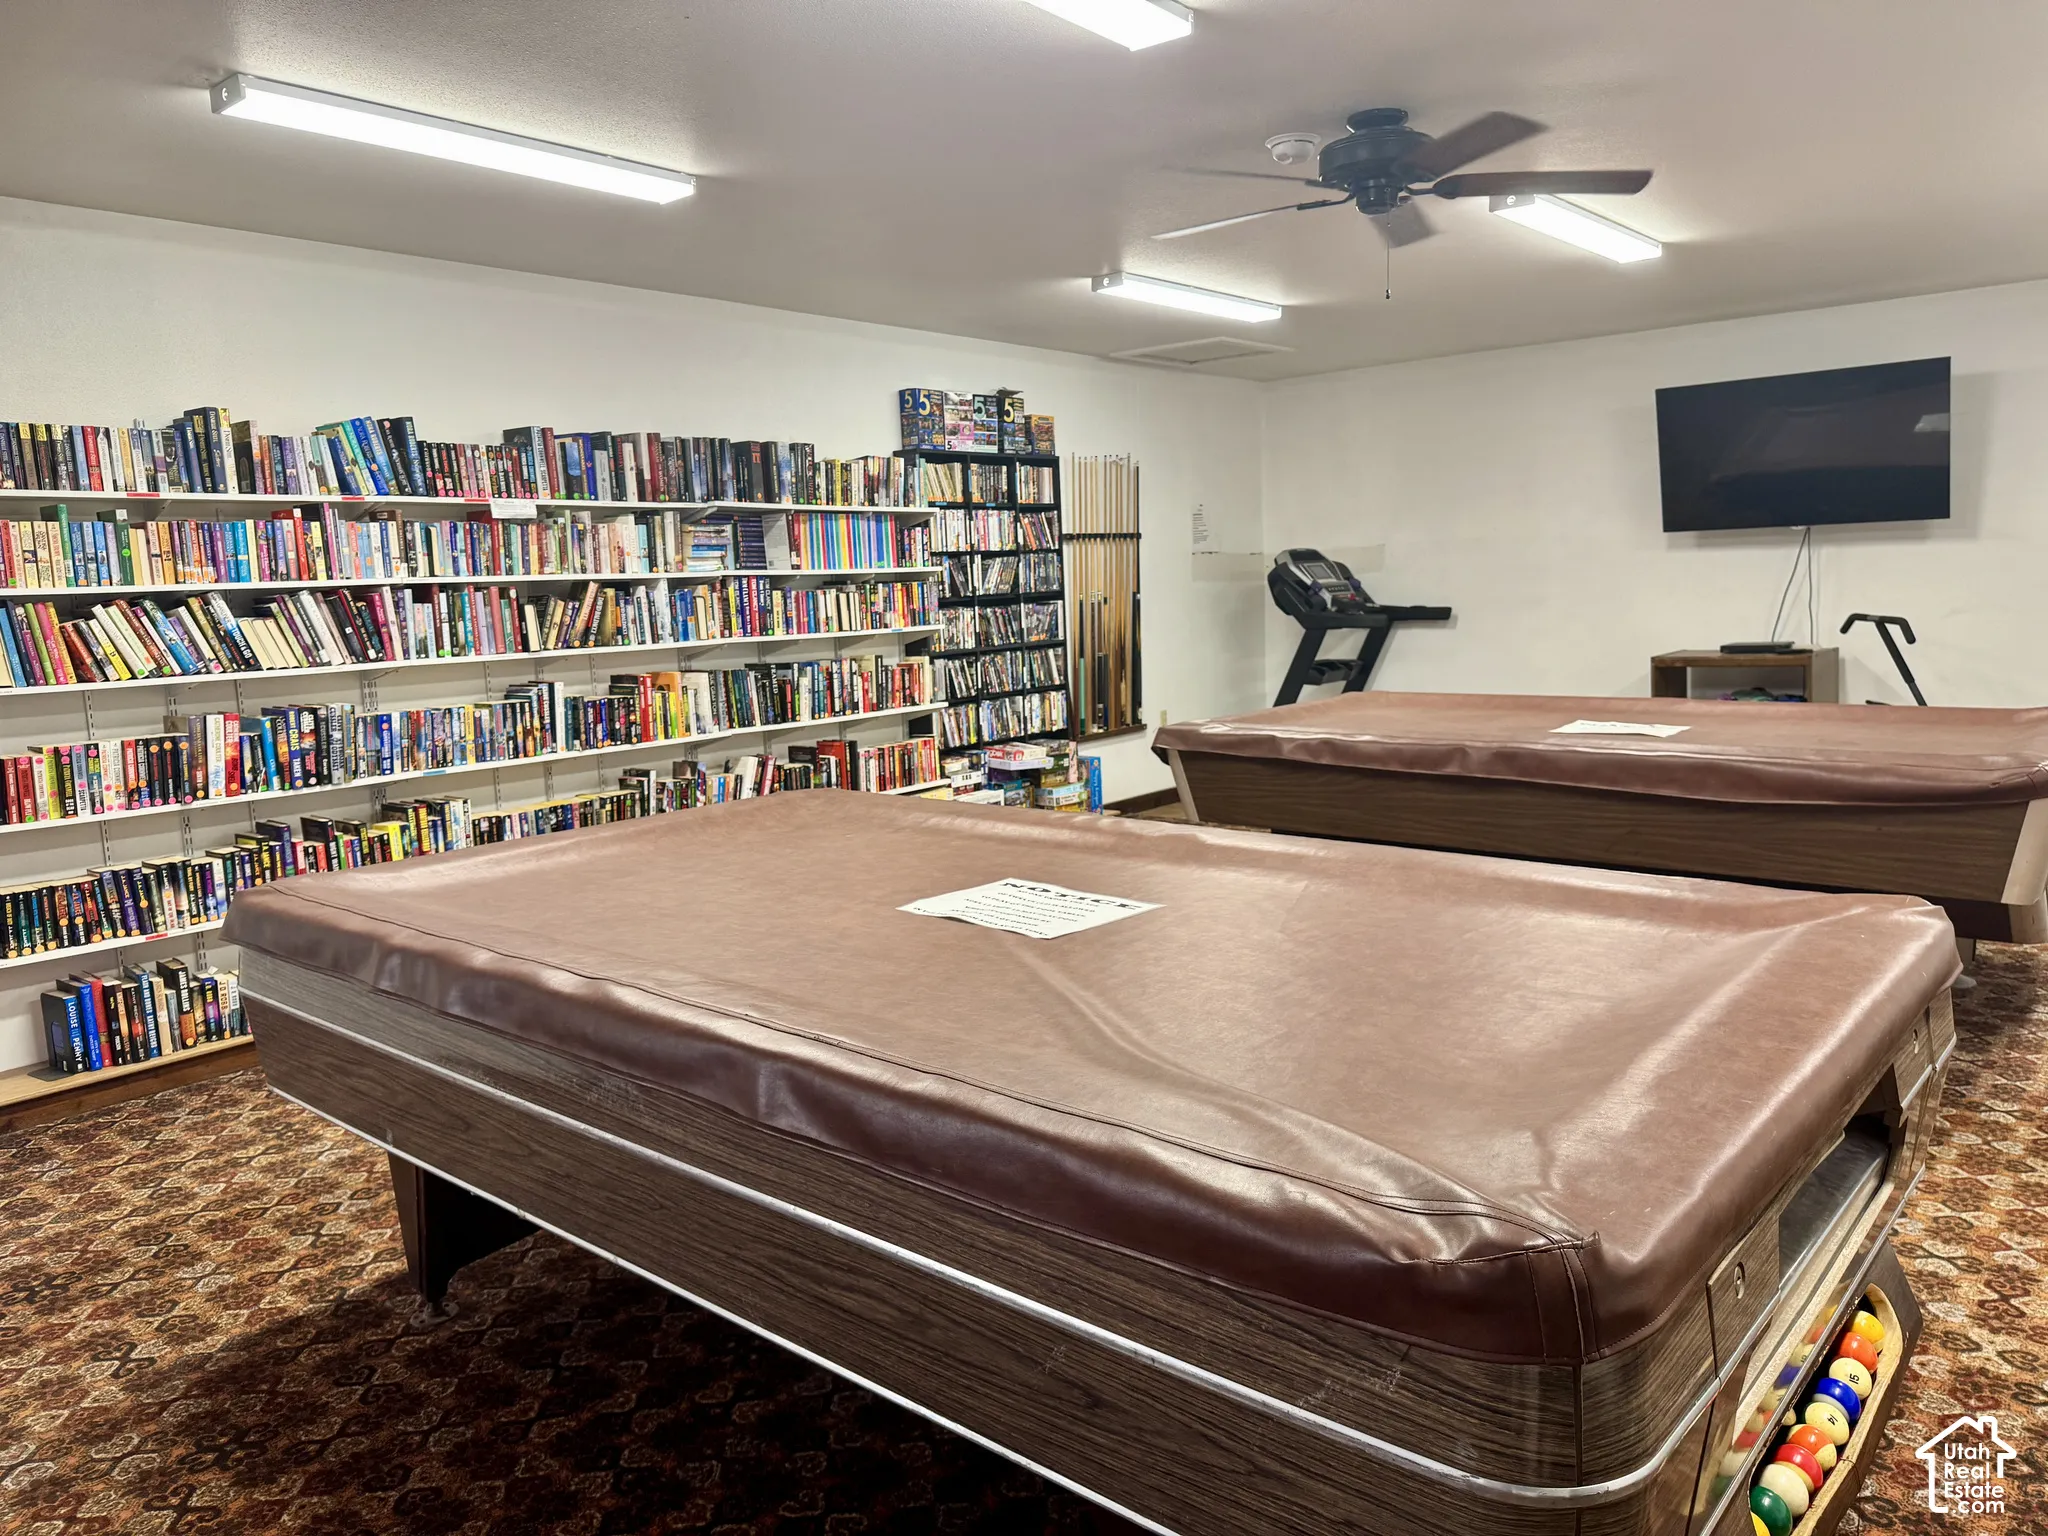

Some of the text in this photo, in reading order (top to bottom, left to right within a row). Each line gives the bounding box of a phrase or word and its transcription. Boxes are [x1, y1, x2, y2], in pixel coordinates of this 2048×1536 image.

[905, 391, 912, 408] 5
[919, 390, 930, 416] 5
[974, 397, 985, 418] 5
[1004, 398, 1013, 422] 5
[591, 611, 602, 634] BALDACCI
[231, 629, 244, 646] TOUCH
[243, 650, 252, 659] GO
[289, 729, 299, 750] CRAIS
[293, 758, 301, 777] TAKEN
[997, 882, 1144, 909] NOTICE
[179, 971, 190, 1011] JAMES ROLLINS
[69, 1002, 81, 1061] LOUISE PENNY
[149, 1030, 157, 1048] REICHS
